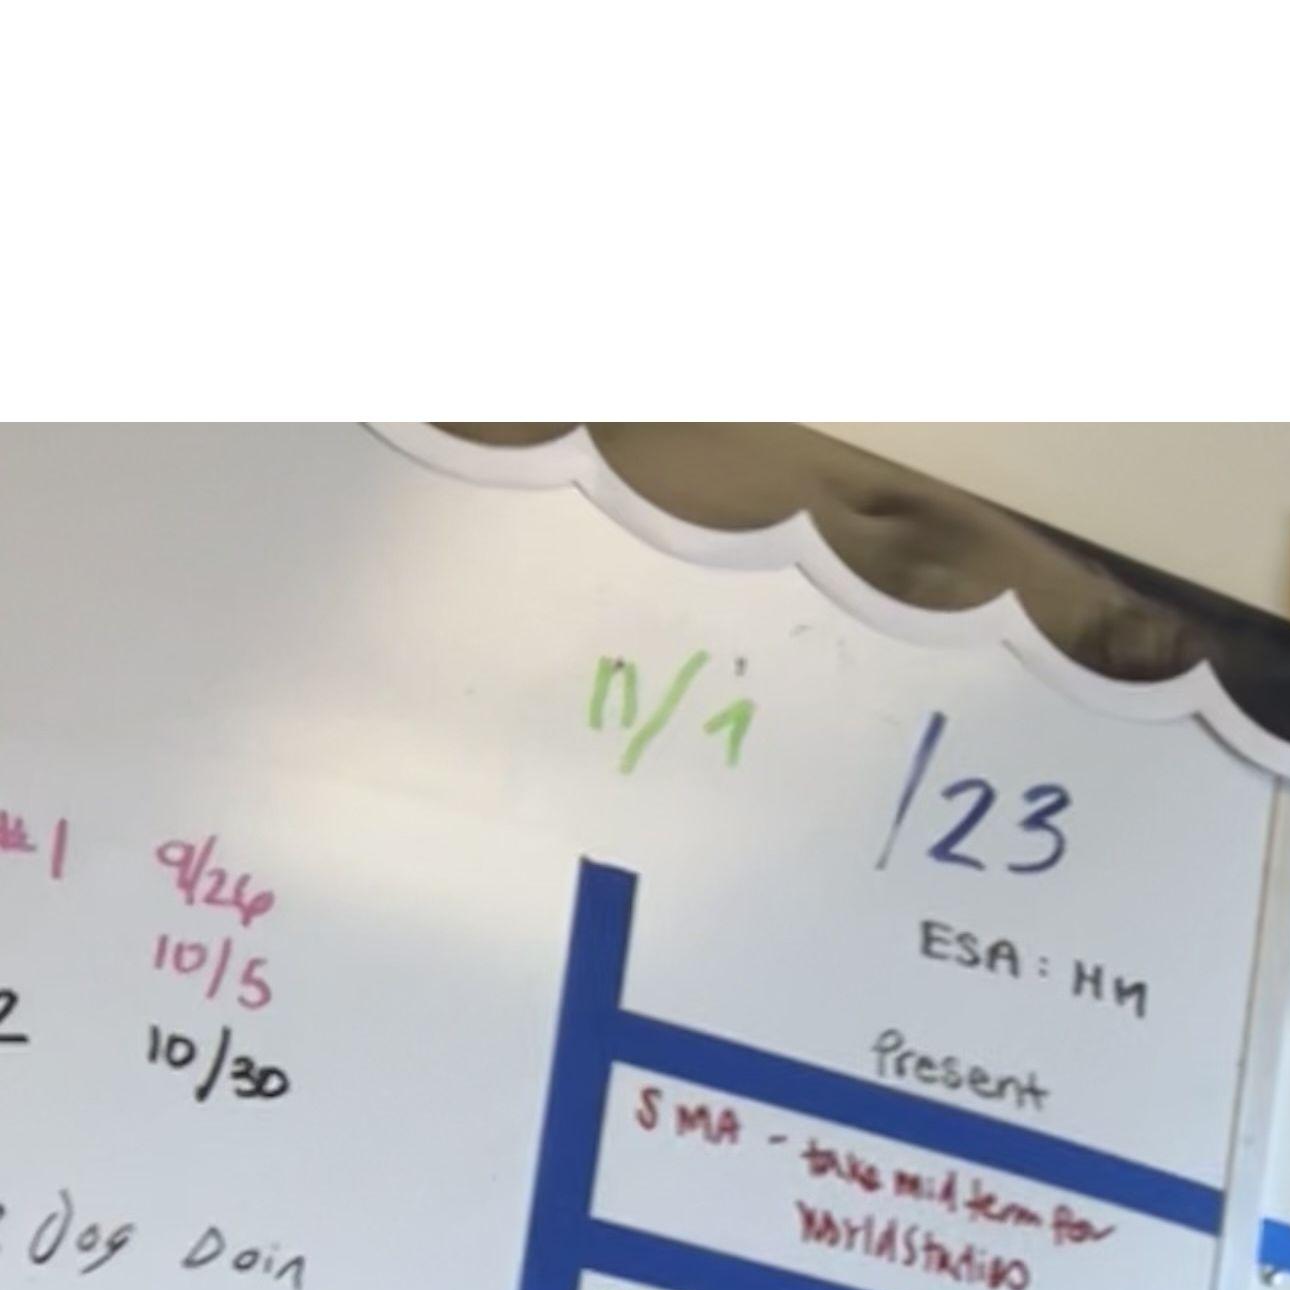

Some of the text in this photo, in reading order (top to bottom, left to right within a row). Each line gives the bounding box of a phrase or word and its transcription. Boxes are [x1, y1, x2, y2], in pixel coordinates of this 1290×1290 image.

[873, 710, 1073, 875] /23
[155, 834, 276, 927] 9/26
[153, 933, 273, 1010] 10/5
[146, 1023, 291, 1104] 10/30
[870, 1028, 1050, 1111] Present
